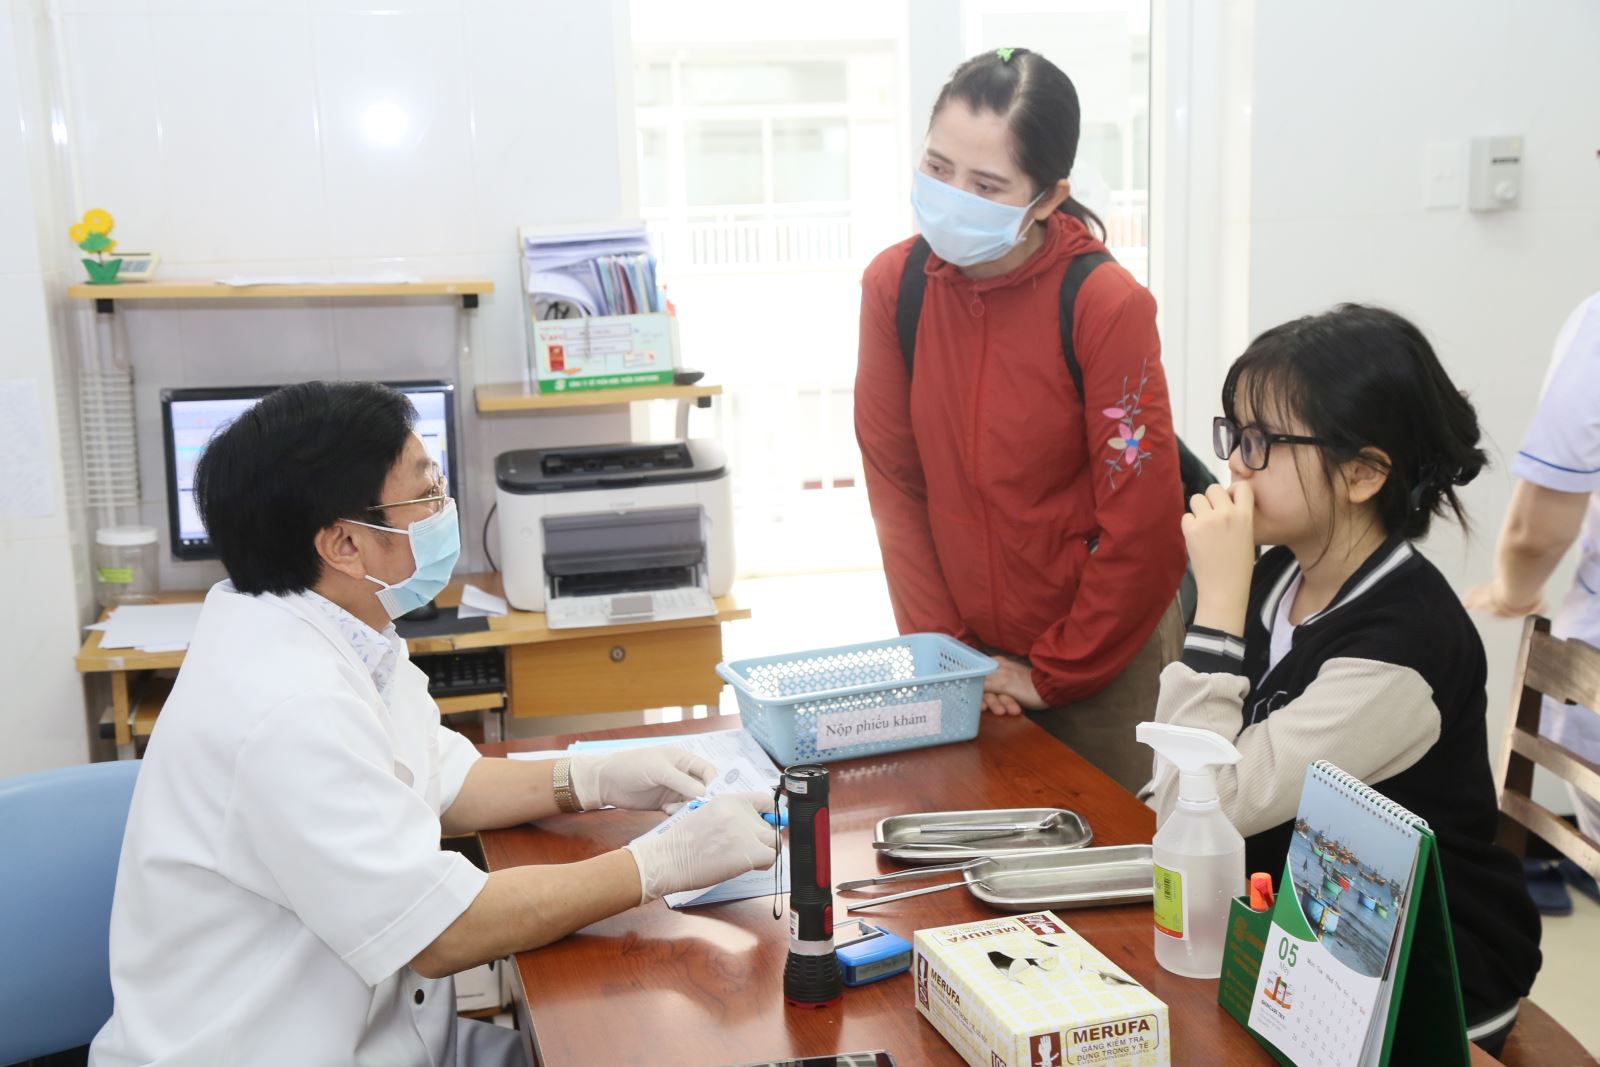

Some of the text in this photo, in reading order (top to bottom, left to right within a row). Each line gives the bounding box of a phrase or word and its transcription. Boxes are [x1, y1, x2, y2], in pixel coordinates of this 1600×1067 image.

[893, 713, 928, 727] khám
[946, 926, 1019, 943] MERUFA
[1278, 936, 1299, 968] 05
[930, 968, 961, 1006] MERUFA
[1073, 1019, 1151, 1044] MERUFA
[1102, 1046, 1129, 1056] TRONG
